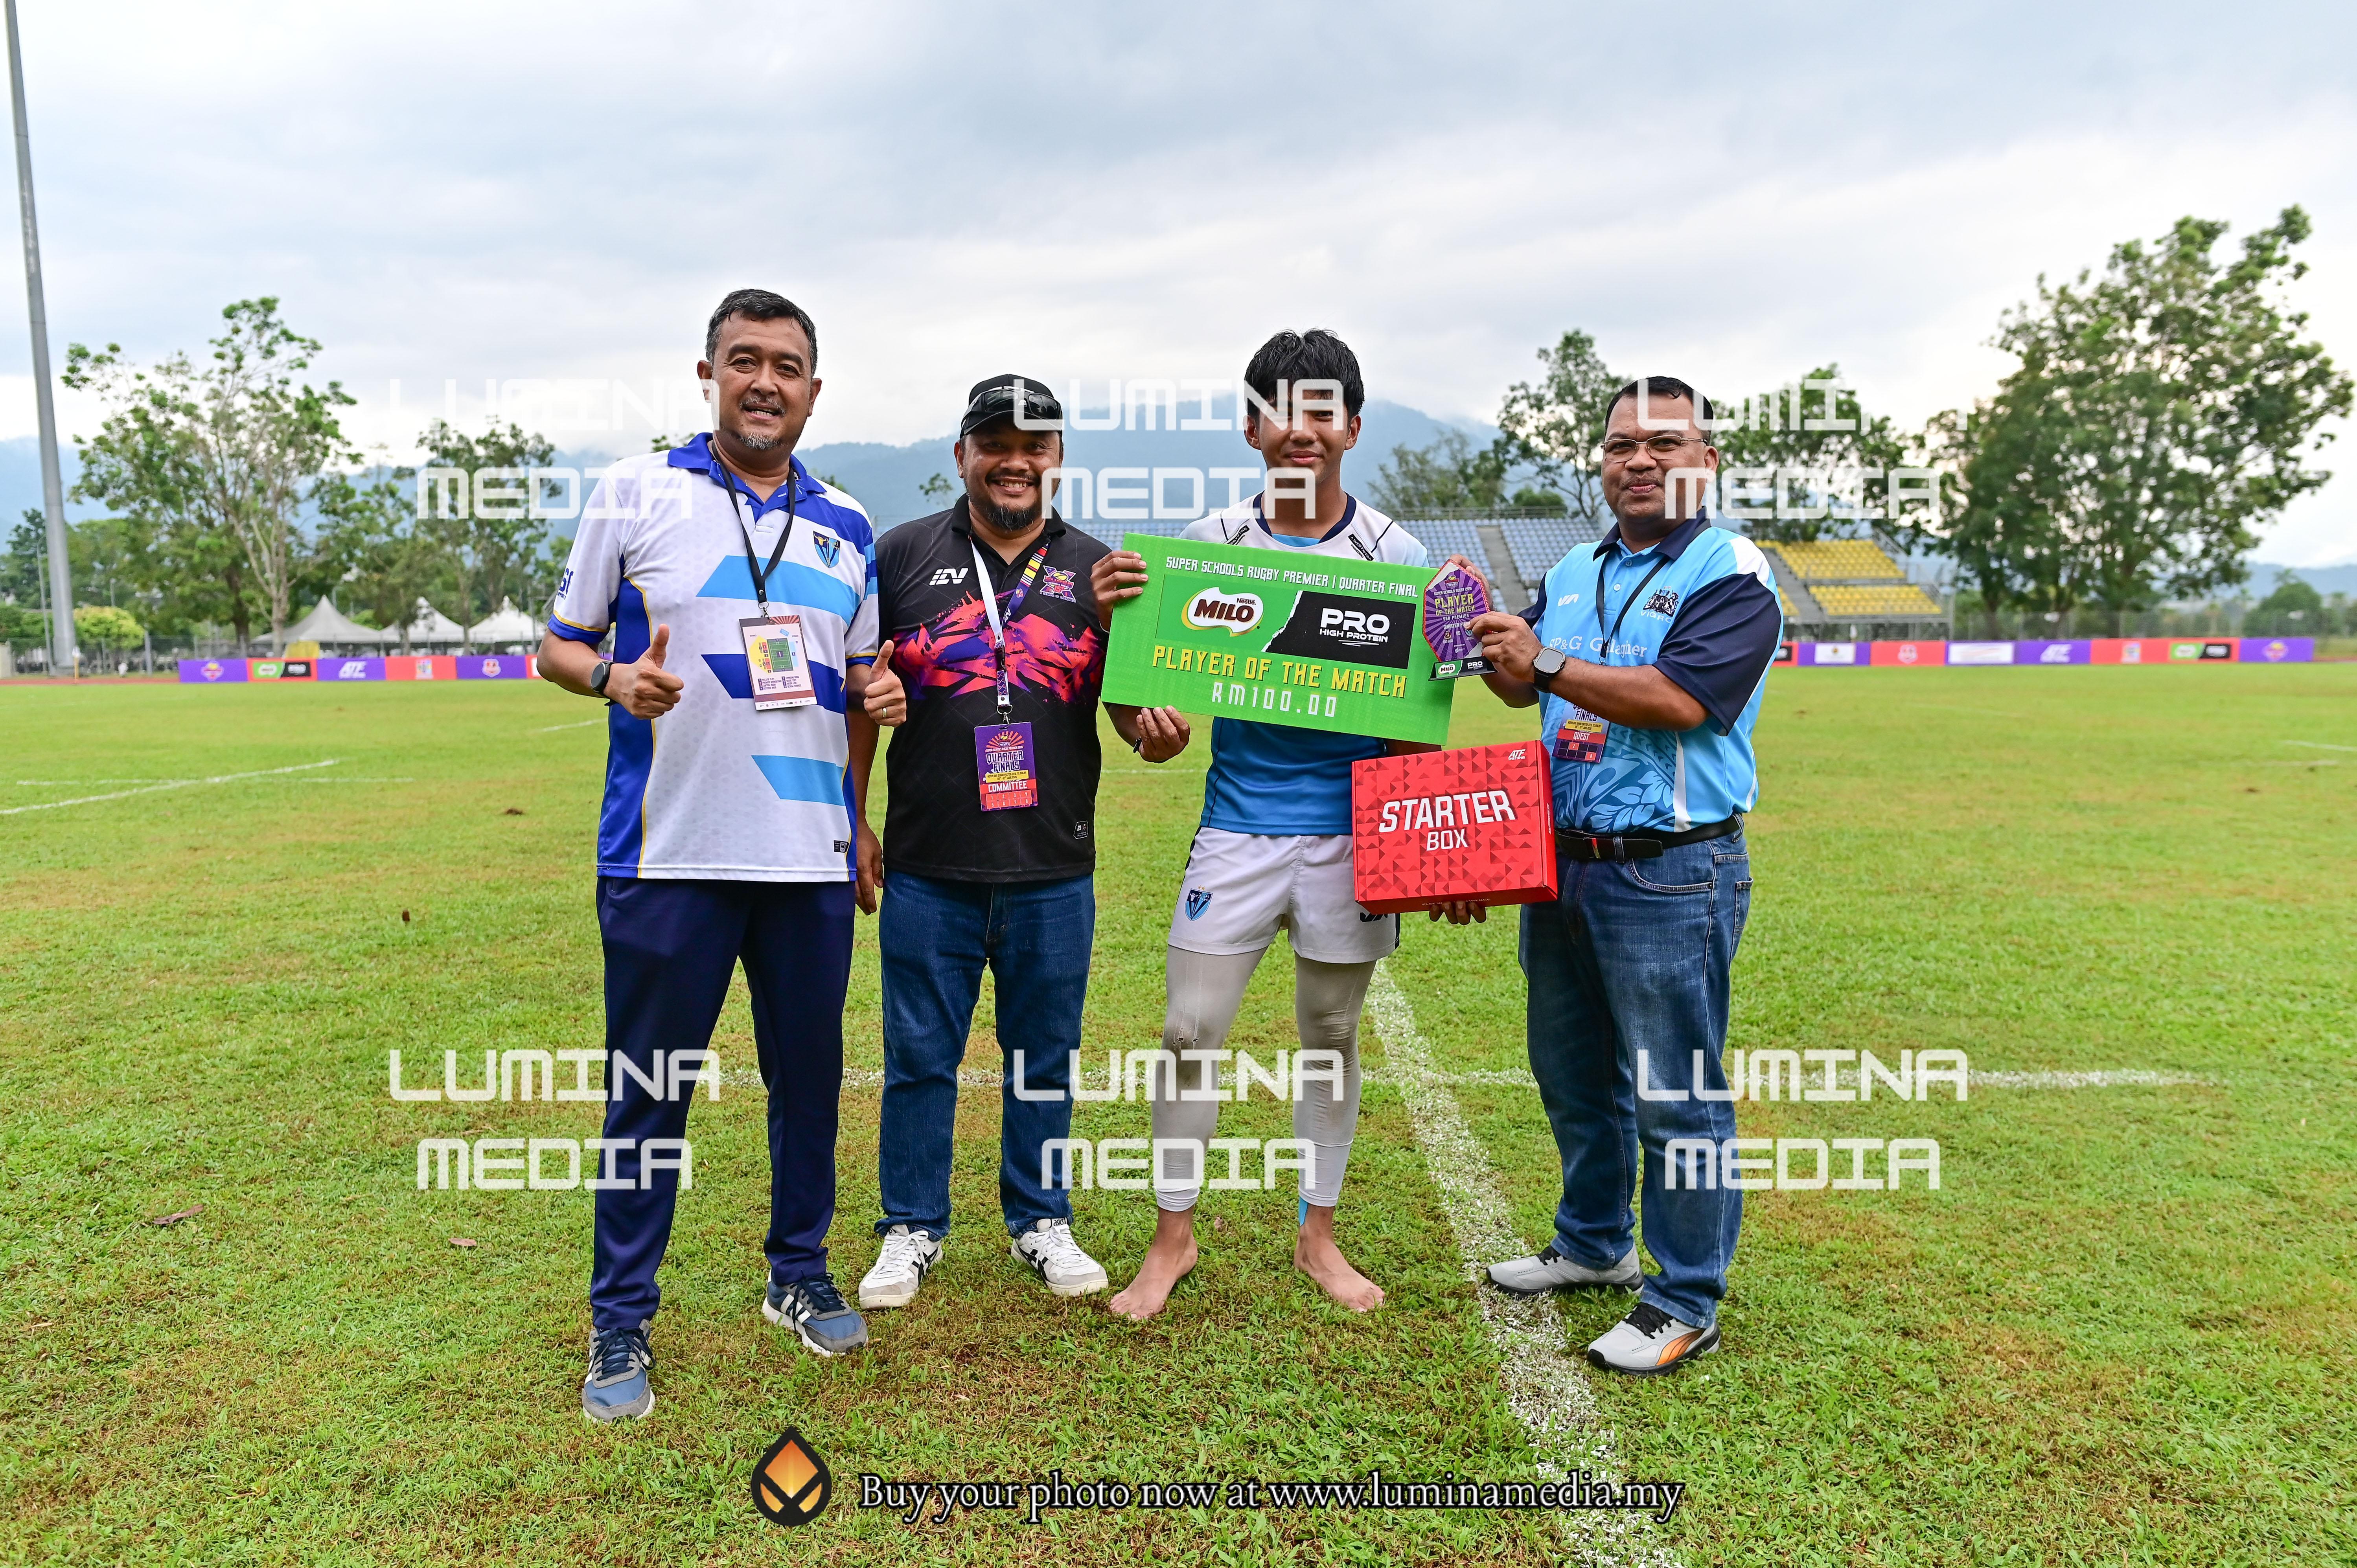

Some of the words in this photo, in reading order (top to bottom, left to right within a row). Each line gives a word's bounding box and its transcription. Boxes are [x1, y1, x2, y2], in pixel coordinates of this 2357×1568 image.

[1166, 556, 1198, 571] SUPER
[1201, 561, 1244, 577] SCHOOLS
[1247, 566, 1280, 581] RUGBY
[1283, 570, 1329, 587] PREMIER
[1339, 577, 1385, 593] QUARTER
[1389, 583, 1418, 597] FINAL
[1435, 594, 1474, 608] PLAYER
[1194, 599, 1254, 622] MILO
[1320, 608, 1390, 634] PRO
[1319, 629, 1344, 637] HIGH
[1346, 632, 1388, 643] PROTEIN
[1152, 645, 1235, 677] PLAYER
[1244, 657, 1272, 680] OF
[1282, 661, 1322, 687] THE
[1330, 667, 1407, 698] MATCH
[1212, 682, 1336, 717] RM100.00
[1575, 710, 1597, 721] FINALS
[1573, 732, 1590, 741] GUEST
[987, 751, 1023, 763] QUARTER
[1509, 749, 1525, 757] ATF
[994, 761, 1019, 772] FINALS
[988, 781, 1027, 792] COMMITTEE
[1378, 790, 1516, 833] STARTER
[1426, 829, 1468, 851] BOX
